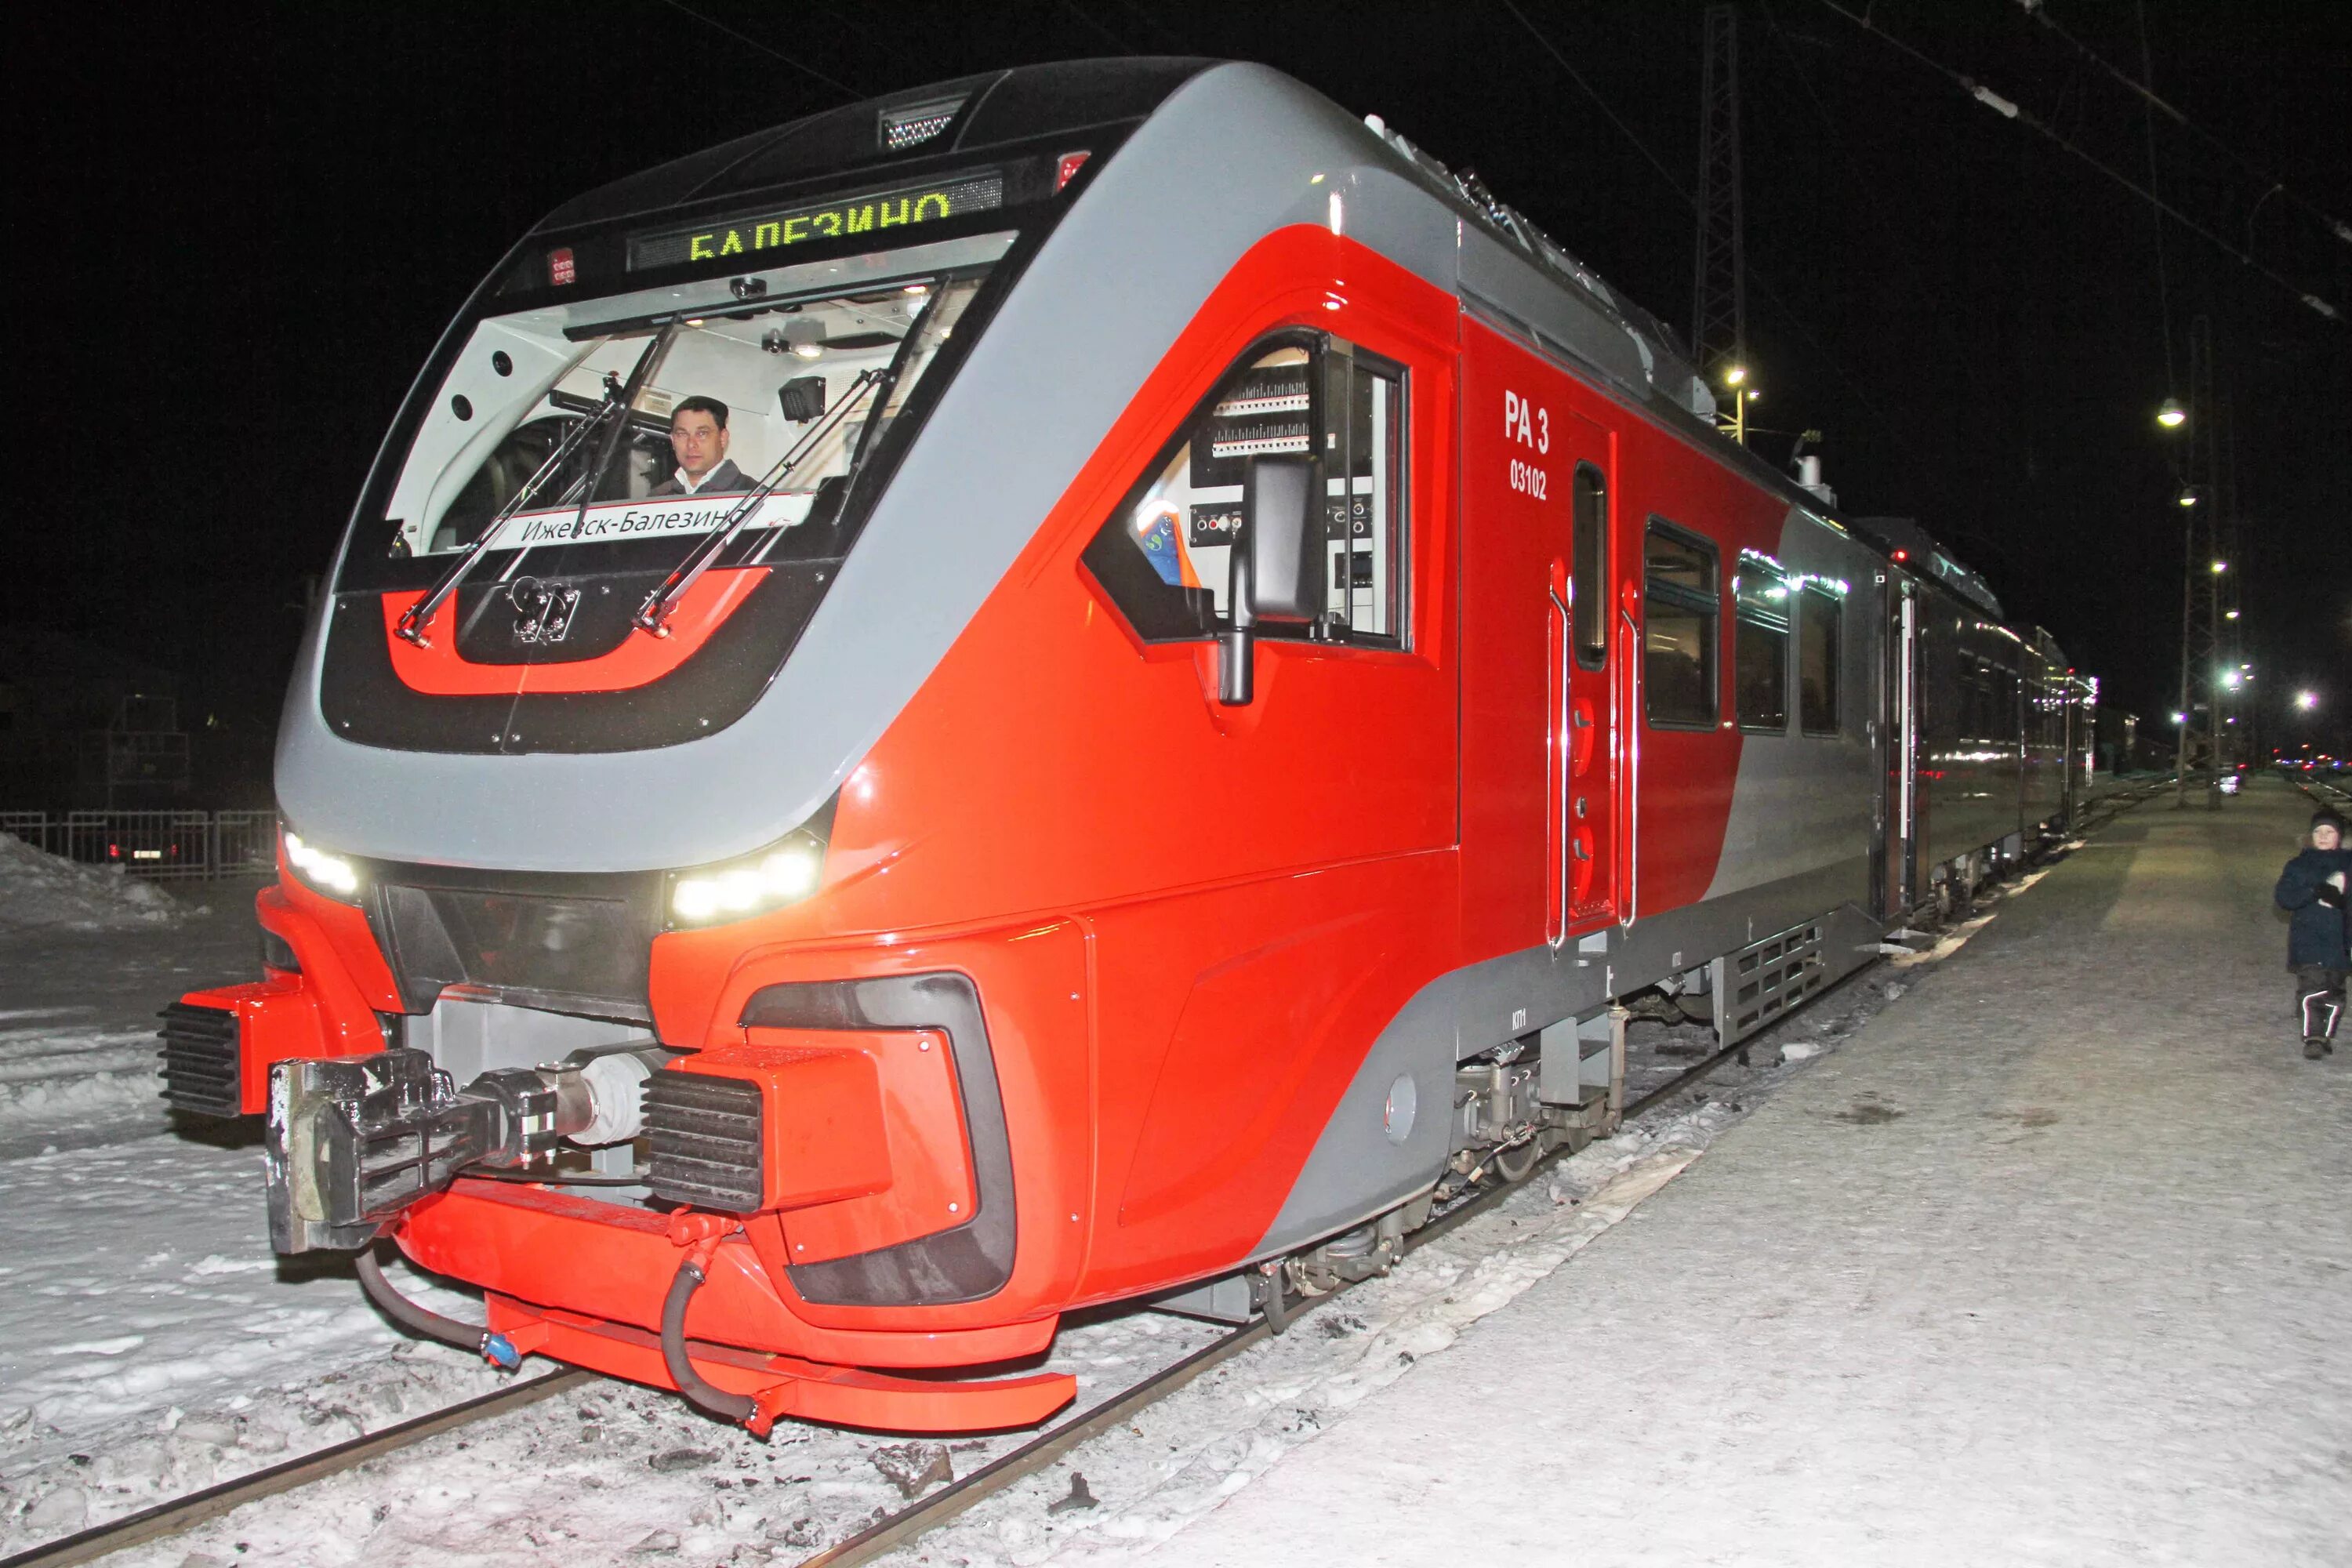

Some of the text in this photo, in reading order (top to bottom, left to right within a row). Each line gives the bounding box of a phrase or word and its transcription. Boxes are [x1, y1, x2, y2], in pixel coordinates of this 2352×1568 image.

[1505, 389, 1549, 455] РА 3
[1510, 458, 1547, 501] 03102
